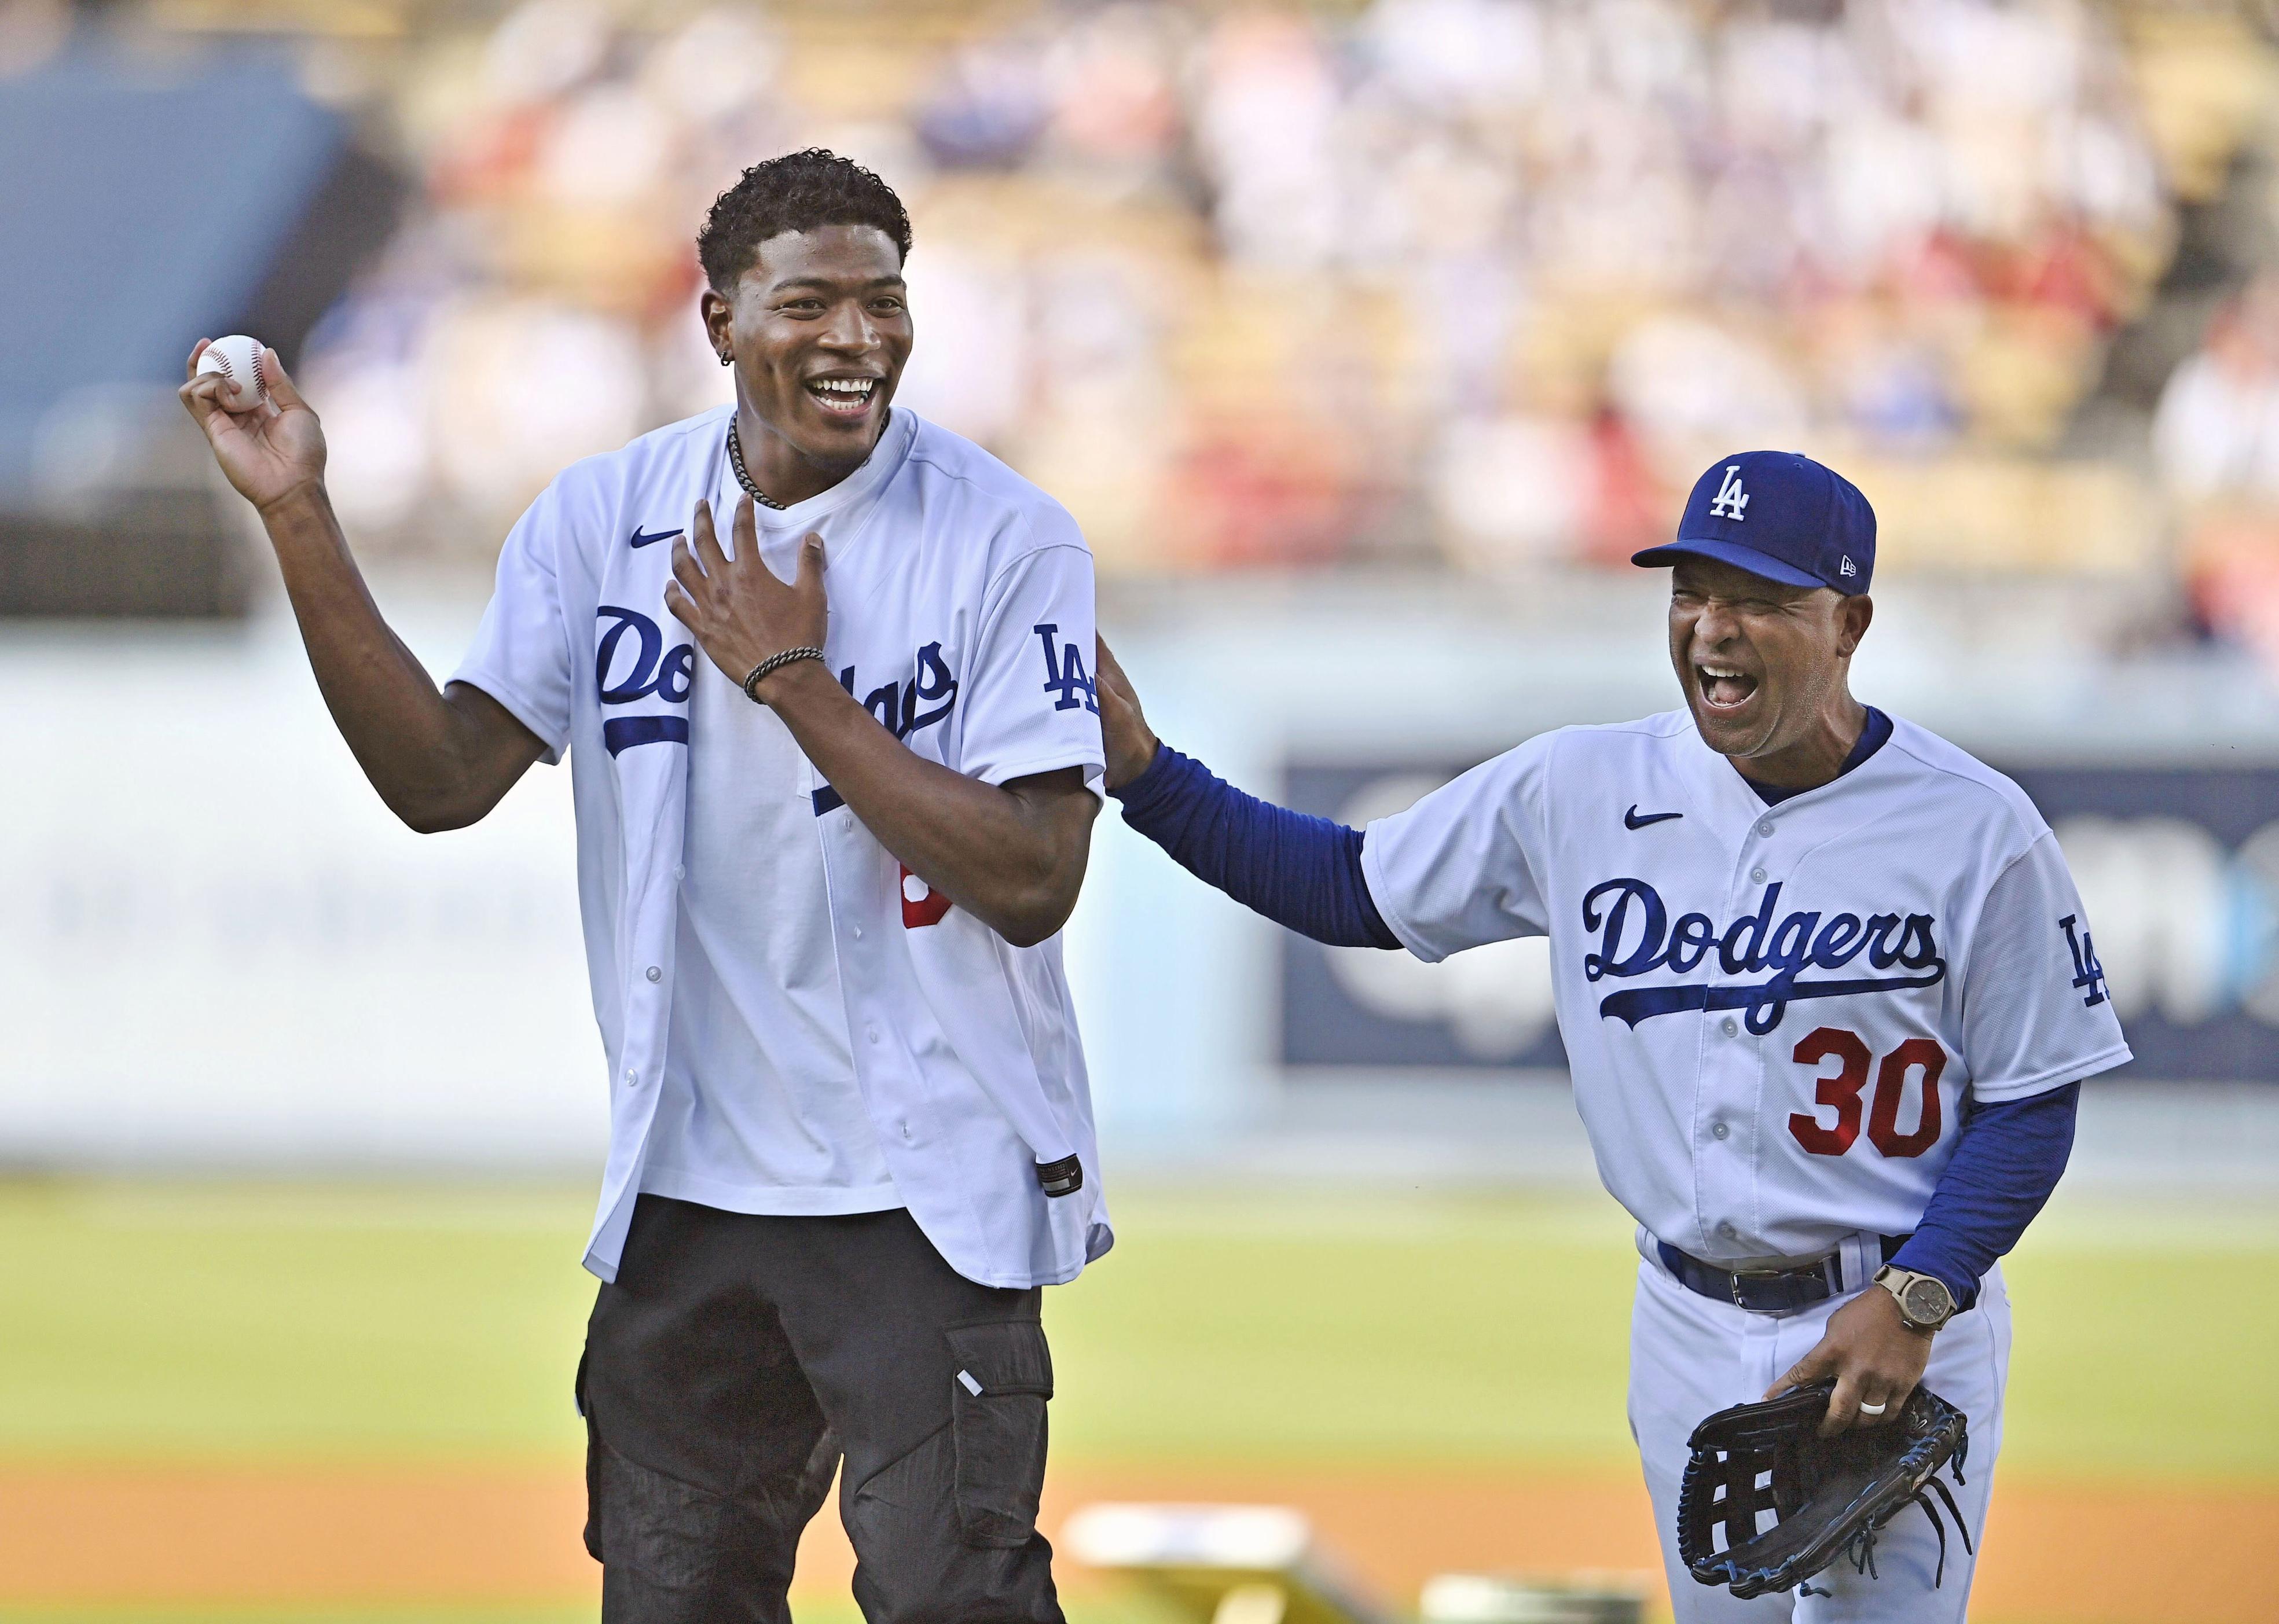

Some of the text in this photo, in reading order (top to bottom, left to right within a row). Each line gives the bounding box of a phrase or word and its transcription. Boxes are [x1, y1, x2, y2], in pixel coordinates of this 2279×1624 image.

[1709, 465, 1750, 521] LA
[1033, 623, 1100, 717] LA
[1582, 877, 1946, 1036] Dodgers
[2058, 913, 2111, 1008] LA
[1788, 1026, 1948, 1158] 30
